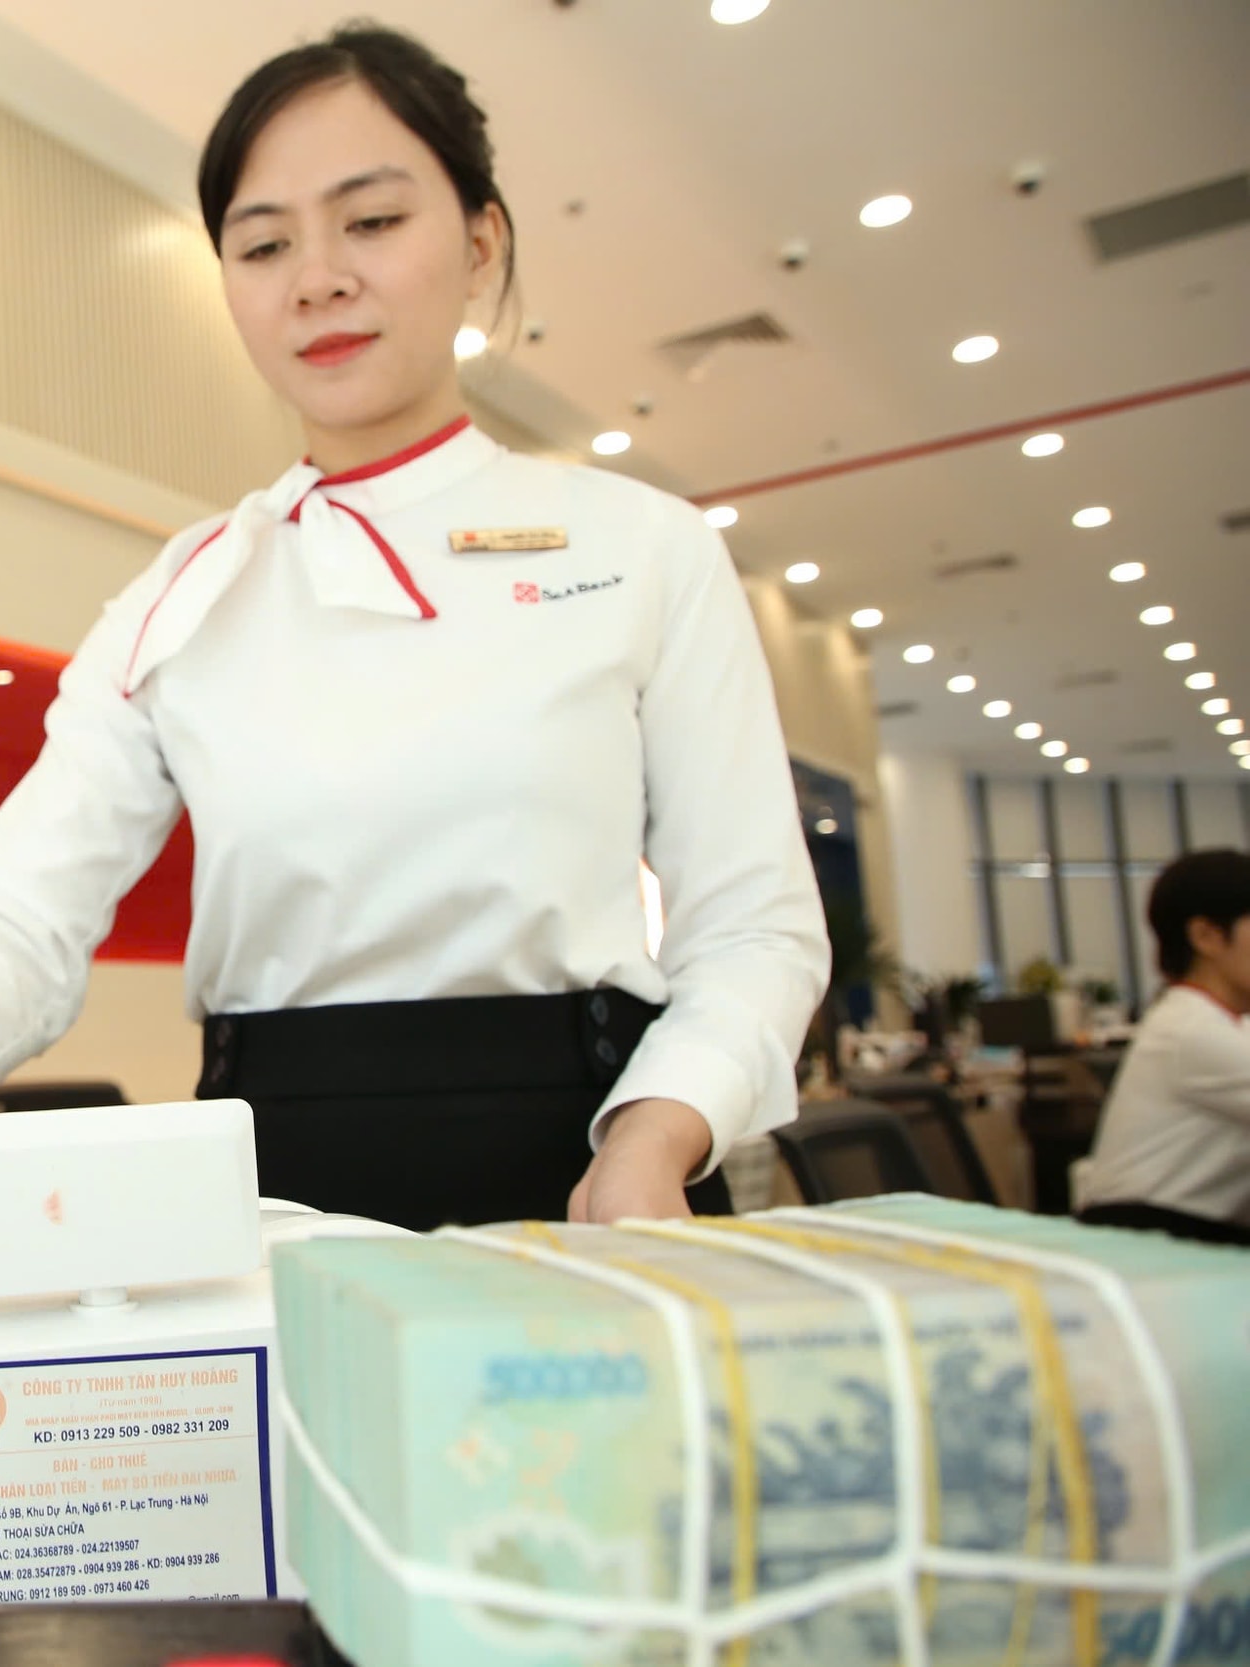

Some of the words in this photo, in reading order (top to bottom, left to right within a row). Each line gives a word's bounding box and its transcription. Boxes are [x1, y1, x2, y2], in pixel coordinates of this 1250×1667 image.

[22, 1378, 62, 1396] CÔNG
[66, 1378, 83, 1394] TY
[85, 1376, 124, 1393] TNHH
[128, 1371, 156, 1390] TÂN
[159, 1371, 187, 1388] HUY
[191, 1367, 239, 1386] HOÀNG
[34, 1430, 57, 1443] KD:
[61, 1428, 90, 1442] 0913
[94, 1427, 115, 1439] 229
[119, 1425, 140, 1438] 509
[151, 1422, 180, 1436] 0982
[184, 1421, 204, 1433] 331
[208, 1419, 230, 1432] 209
[90, 1456, 114, 1470] CHO
[30, 1481, 56, 1499] LOẠI
[9, 1507, 24, 1519] 9B,
[26, 1506, 45, 1517] Khu
[46, 1504, 60, 1518] Dự
[65, 1501, 80, 1515] Án,
[82, 1502, 100, 1516] Ngõ
[102, 1501, 112, 1512] 61
[120, 1499, 128, 1511] P.
[130, 1498, 146, 1512] Lạc
[148, 1497, 173, 1512] Trung
[180, 1494, 192, 1506] Hà
[194, 1493, 209, 1507] Nội
[3, 1526, 33, 1541] THOẠI
[34, 1522, 56, 1538] SỬA
[56, 1521, 85, 1536] CHỮA
[14, 1544, 74, 1560] 024.36368789
[81, 1539, 139, 1554] 024.22139507
[16, 1565, 76, 1580] 028.35472879
[83, 1562, 104, 1575] 0904
[106, 1561, 122, 1573] 939
[124, 1560, 140, 1572] 286
[146, 1558, 163, 1569] KD:
[165, 1556, 185, 1568] 0904
[187, 1554, 203, 1566] 939
[204, 1552, 220, 1564] 286
[29, 1587, 50, 1600] 0912
[53, 1586, 68, 1598] 189
[70, 1584, 86, 1597] 509
[93, 1582, 114, 1595] 0973
[116, 1580, 132, 1592] 460
[134, 1579, 150, 1591] 426
